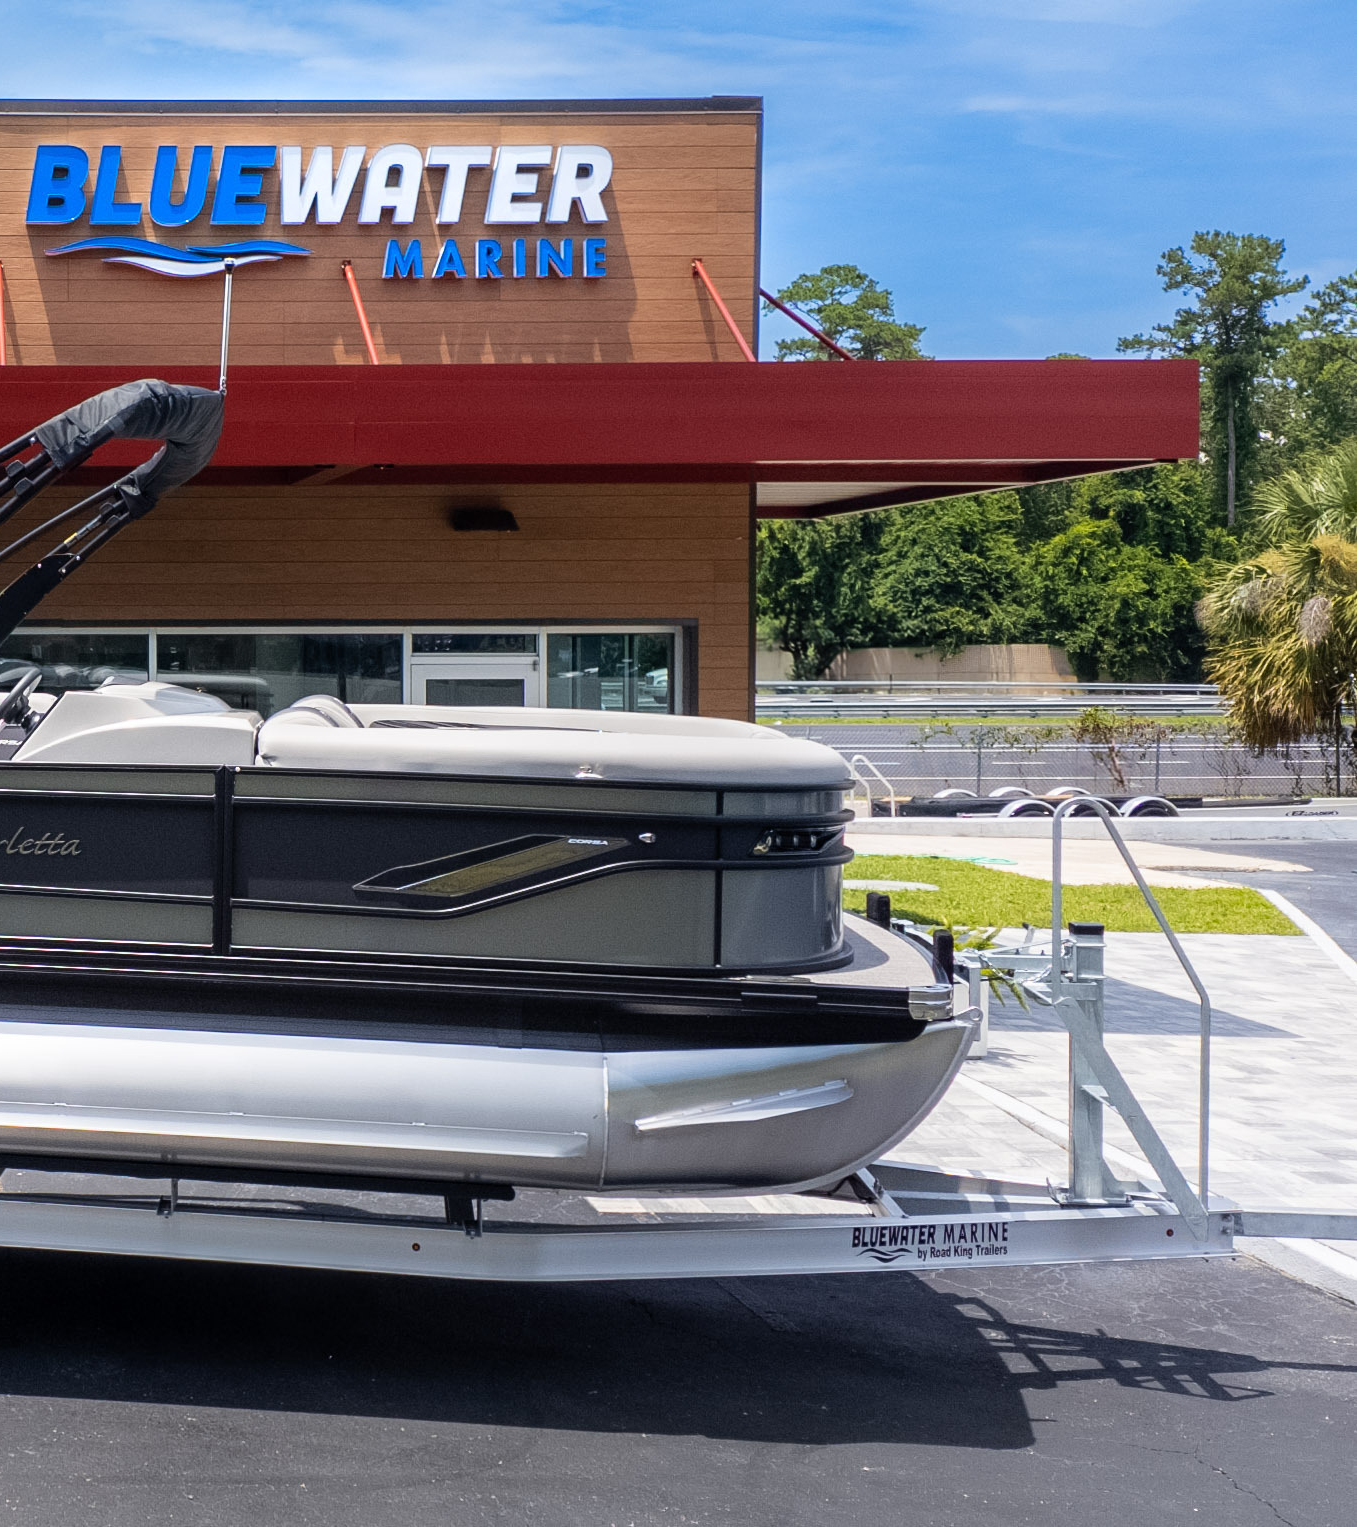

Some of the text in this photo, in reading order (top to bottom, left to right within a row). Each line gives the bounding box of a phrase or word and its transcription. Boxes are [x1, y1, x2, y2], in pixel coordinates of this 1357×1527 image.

[25, 143, 614, 227] BLUEWATER
[381, 238, 608, 279] MARINE
[567, 838, 609, 846] CORSA
[851, 1222, 1009, 1248] BLUEWATER MARINE
[917, 1244, 1008, 1262] by Road King Trailers
